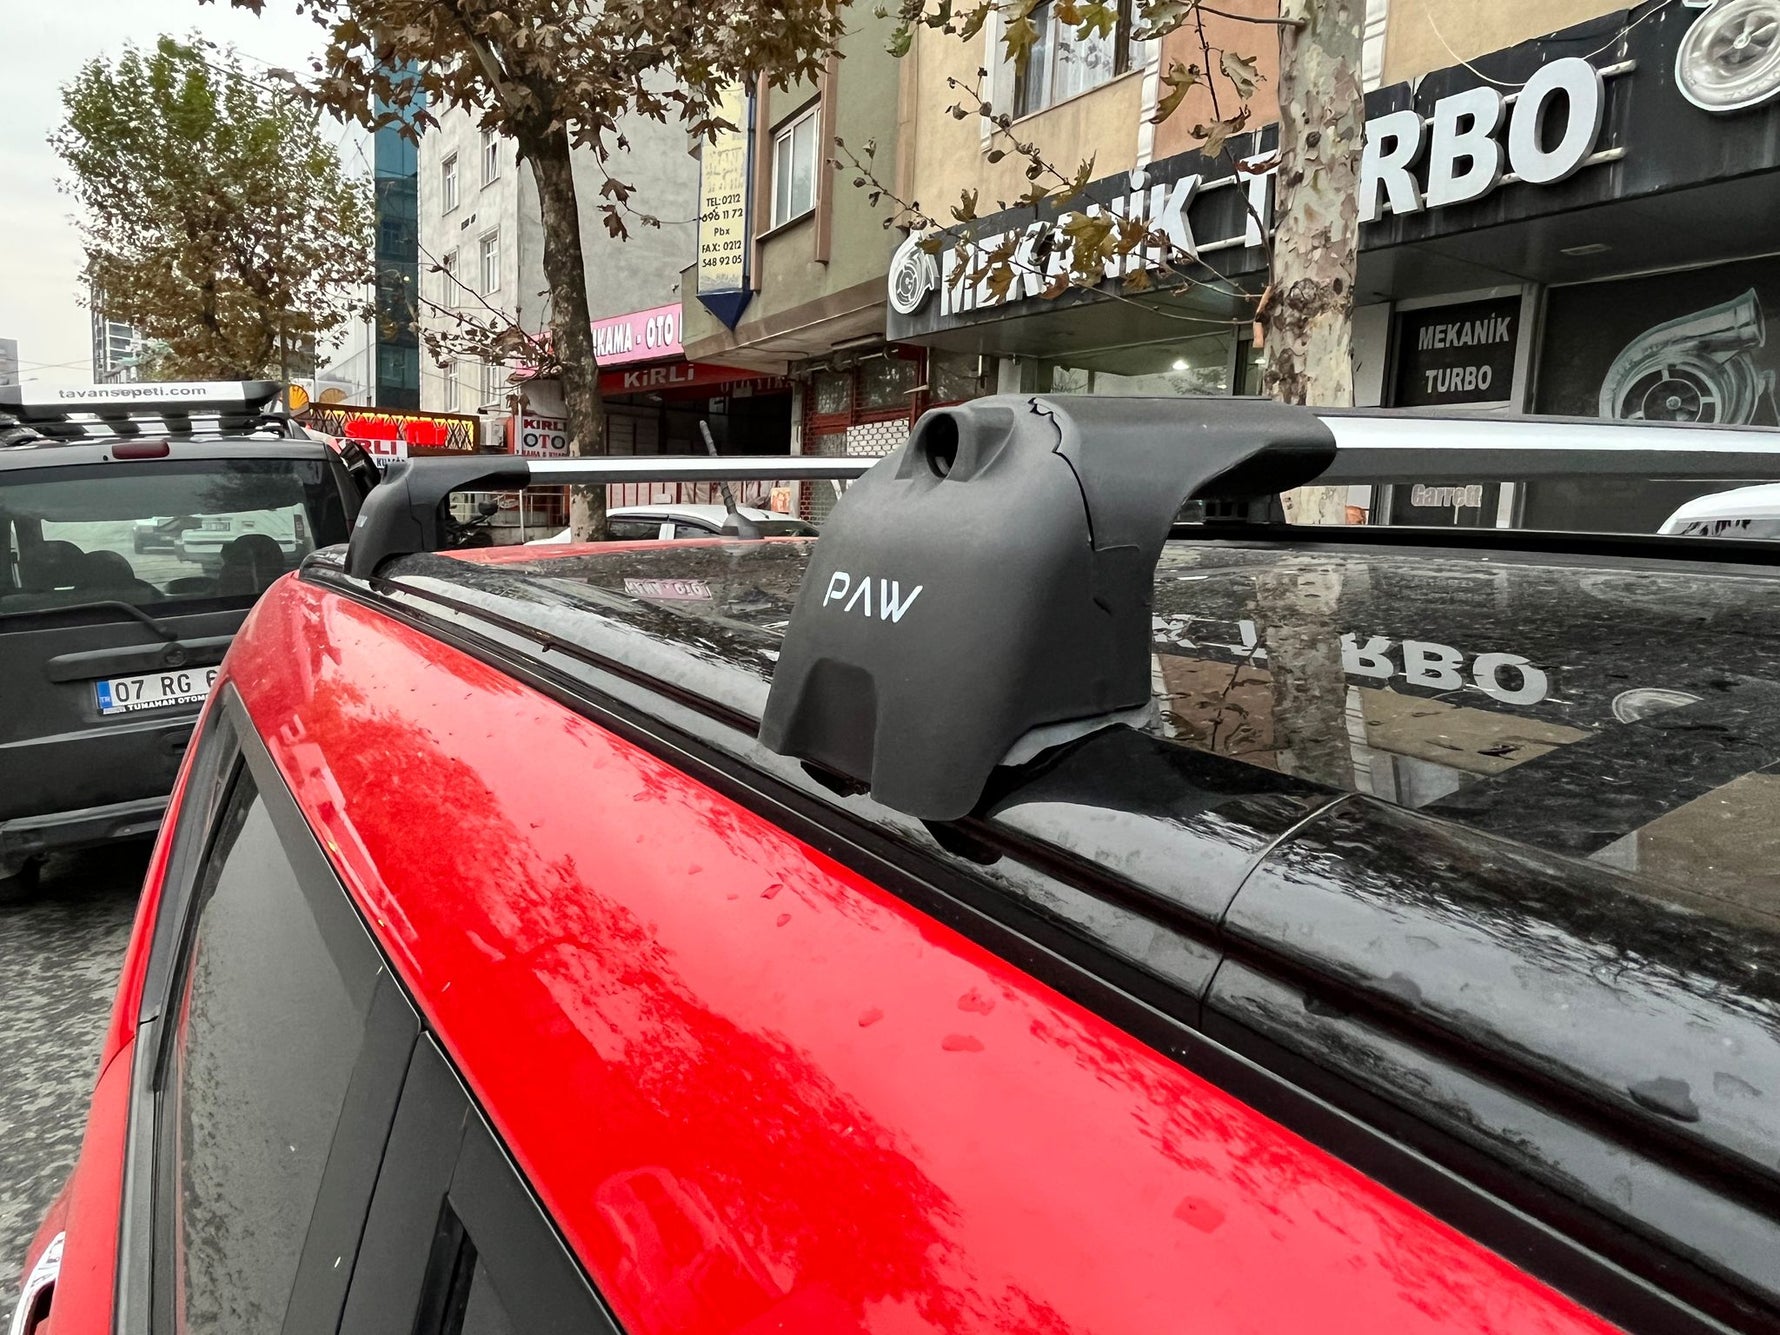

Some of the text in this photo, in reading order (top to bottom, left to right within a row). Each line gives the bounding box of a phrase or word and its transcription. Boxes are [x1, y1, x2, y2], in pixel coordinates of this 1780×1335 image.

[1236, 57, 1604, 247] TRBO
[732, 208, 743, 218] 72
[714, 227, 730, 236] Pbx
[702, 240, 741, 254] FAX: 0212
[702, 255, 742, 268] 548 92 05
[646, 313, 674, 349] OTO
[1419, 312, 1511, 350] MEKANİK
[1425, 365, 1492, 393] TURBO
[59, 386, 206, 399] tavansepeti.com
[523, 433, 566, 449] OTO
[823, 571, 923, 623] PAW
[115, 679, 144, 703] 07
[160, 674, 191, 696] RG
